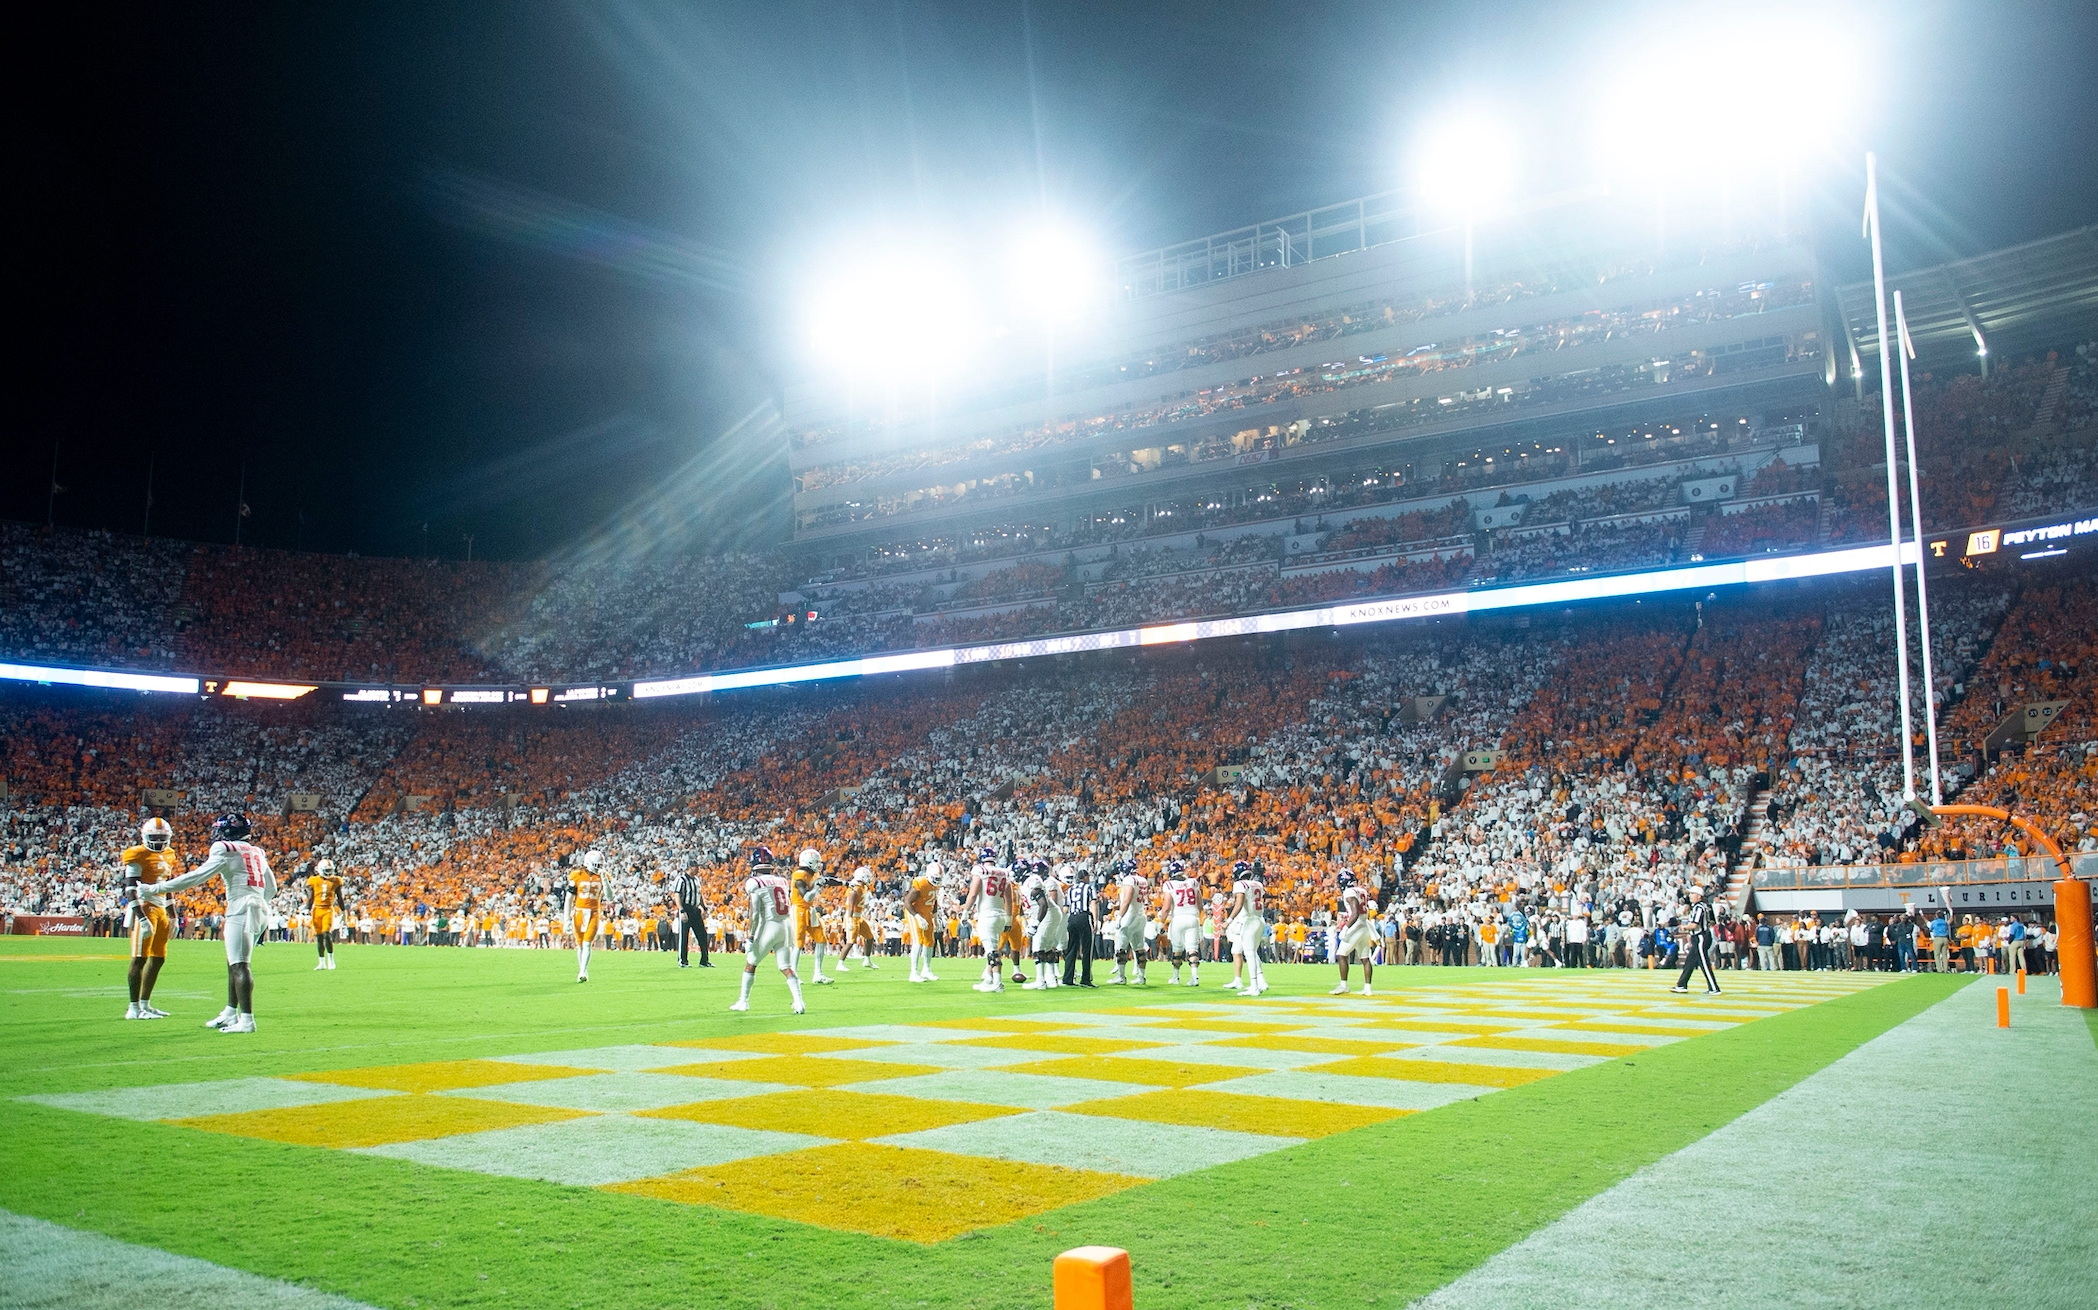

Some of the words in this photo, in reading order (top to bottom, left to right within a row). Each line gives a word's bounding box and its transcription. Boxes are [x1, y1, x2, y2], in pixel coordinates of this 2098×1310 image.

[1976, 535, 1990, 551] 16
[2003, 523, 2072, 546] PEYTON
[1930, 540, 1948, 557] T
[1349, 599, 1450, 618] KNOXNEWS.COM
[205, 681, 217, 692] T
[156, 860, 171, 883] 2
[241, 853, 265, 888] 11
[321, 883, 328, 900] 1
[578, 881, 602, 899] 33
[986, 876, 1007, 898] 64
[1071, 888, 1082, 902] C
[774, 886, 788, 916] 0
[1175, 887, 1196, 907] 78
[1254, 888, 1262, 911] 2
[1899, 892, 1911, 905] T
[50, 922, 88, 933] Hardee
